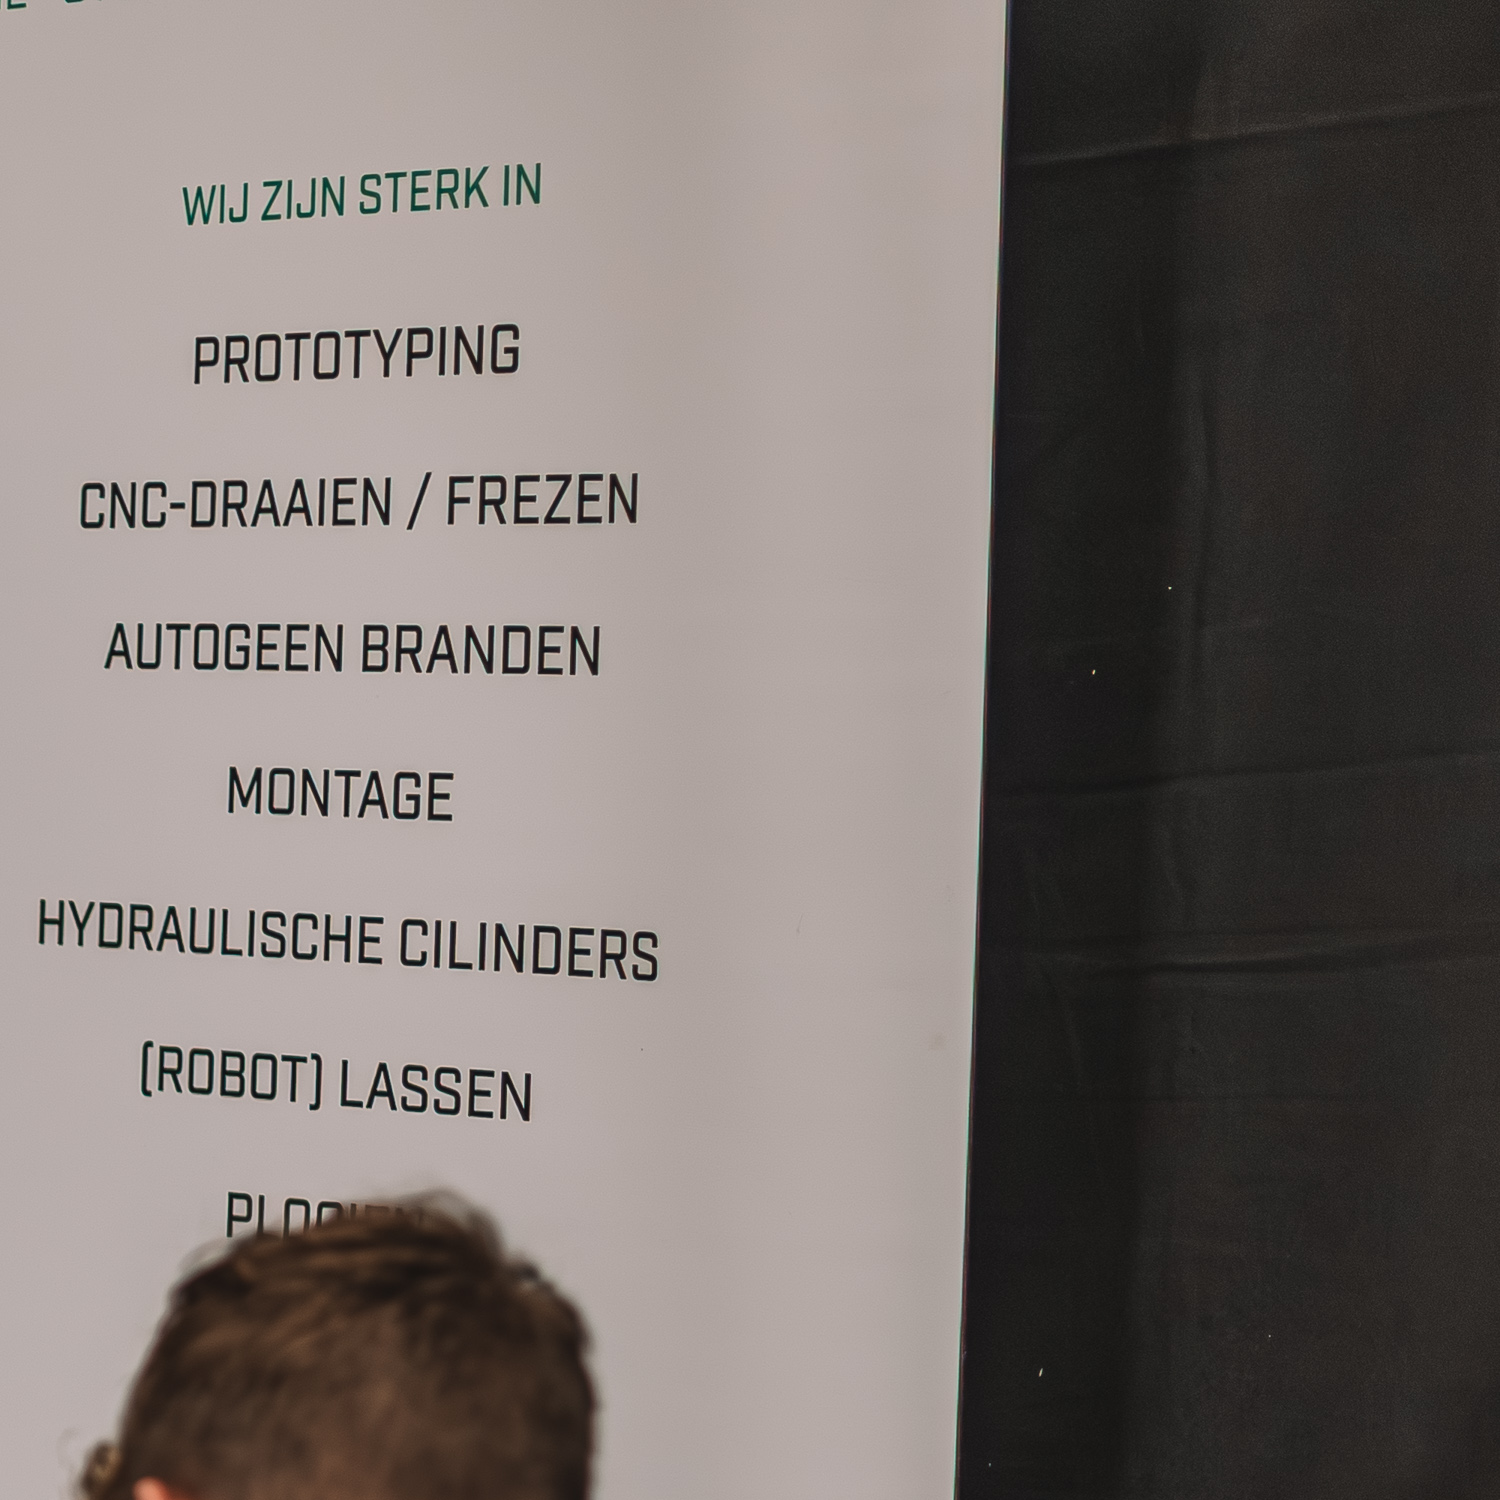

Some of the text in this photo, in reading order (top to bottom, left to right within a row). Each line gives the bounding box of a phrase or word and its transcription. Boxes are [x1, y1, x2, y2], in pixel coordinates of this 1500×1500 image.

[182, 162, 542, 226] WIJ ZIJN STERK IN
[193, 323, 520, 385] PROTOTYPING
[80, 471, 639, 531] CNC-DRAAIEN / FREZEN
[103, 622, 601, 676] AUTOGEEN BRANDEN
[227, 766, 455, 822] MONTAGE
[38, 898, 659, 982] HYDRAULISCHE CILINDERS
[141, 1040, 532, 1122] (ROBOT) LASSEN
